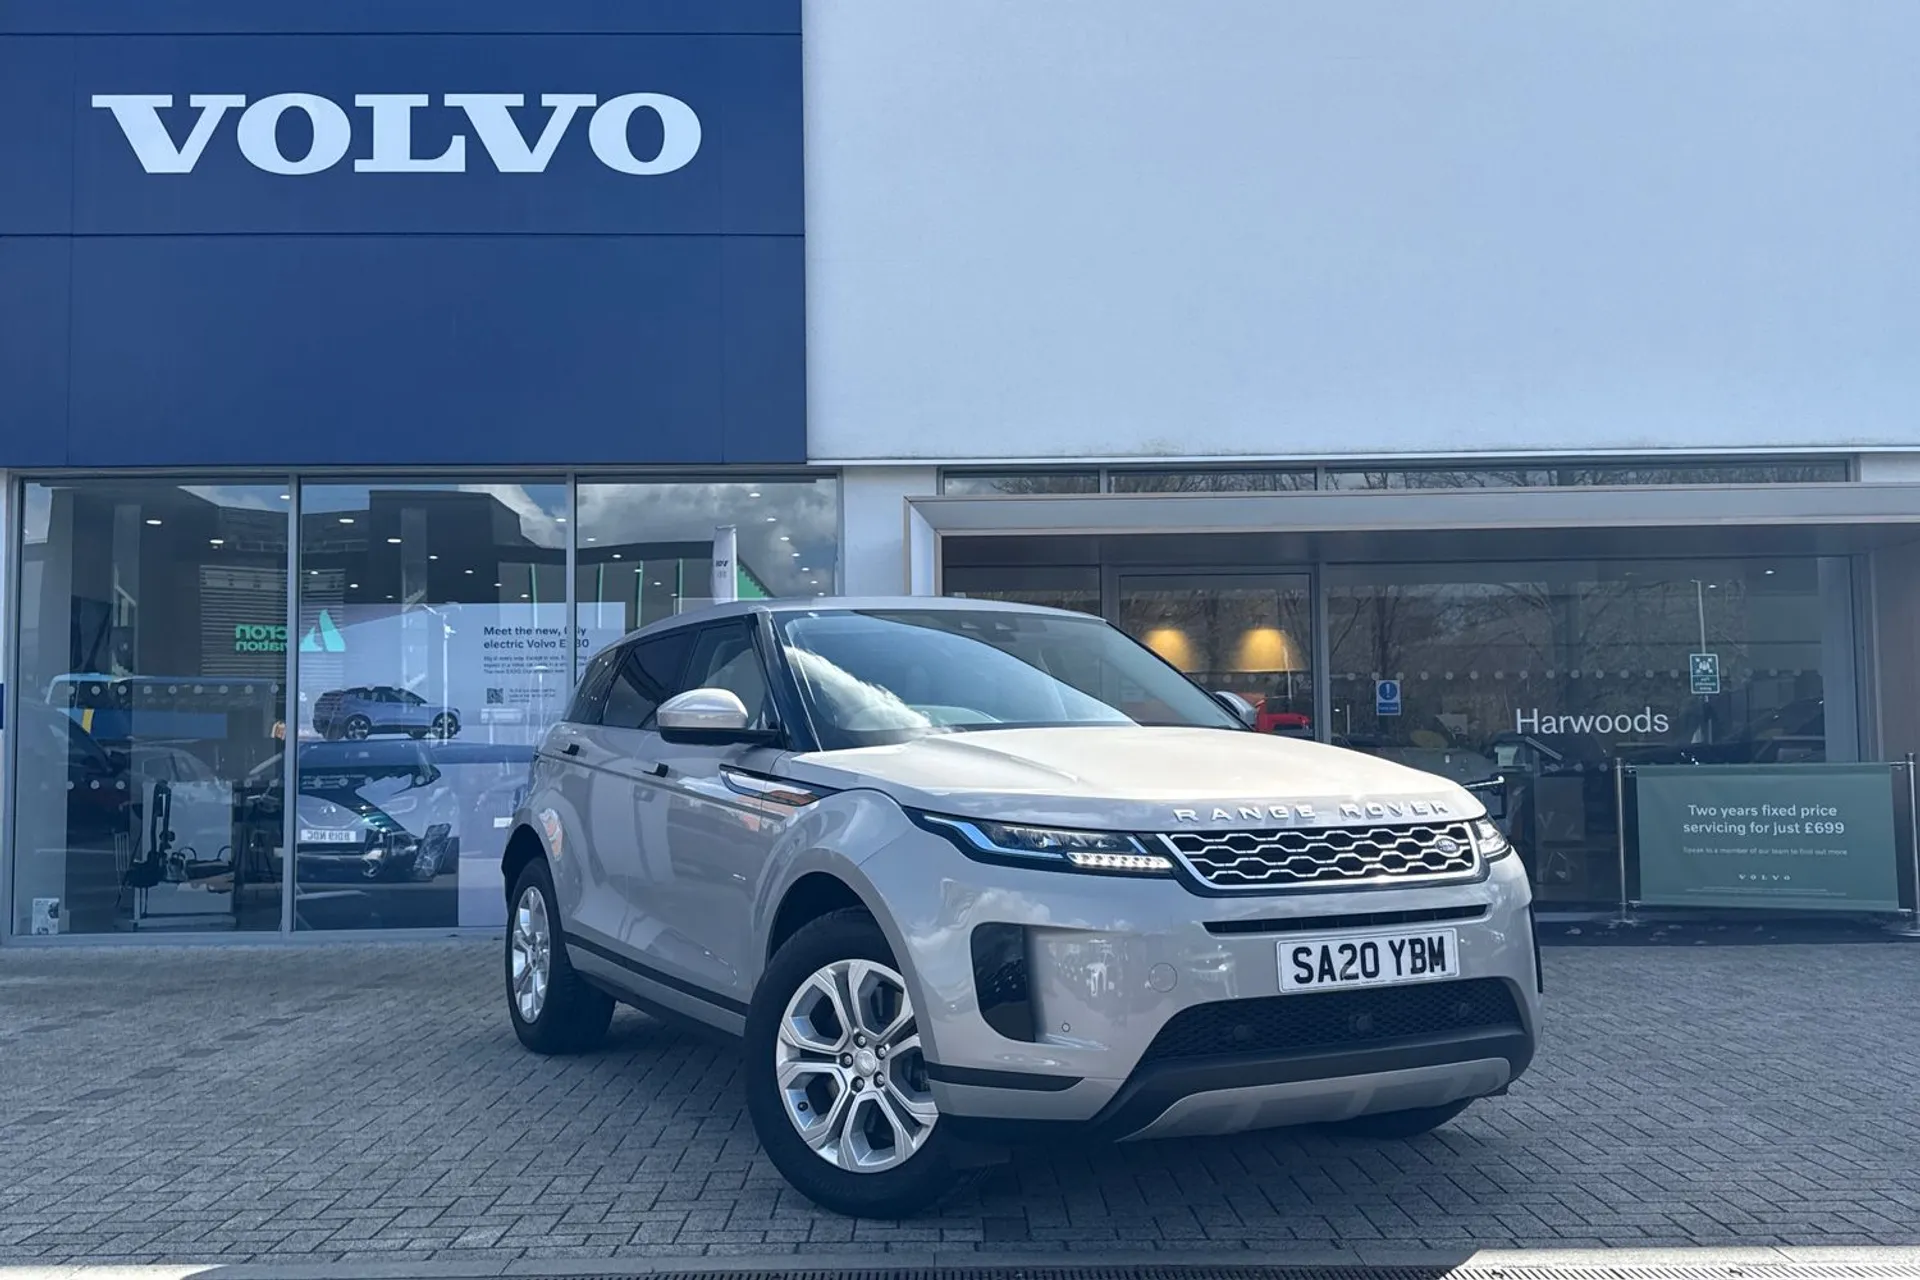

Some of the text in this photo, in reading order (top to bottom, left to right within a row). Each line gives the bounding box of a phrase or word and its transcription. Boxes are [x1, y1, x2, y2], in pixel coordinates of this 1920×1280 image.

[92, 92, 701, 175] VOLVO
[483, 626, 512, 635] Meet
[515, 626, 532, 635] the
[535, 626, 561, 637] new,
[483, 639, 524, 649] electric
[527, 639, 556, 648] Volvo
[1516, 706, 1670, 735] Harwoods
[1173, 800, 1449, 823] RANGE ROVER
[1688, 804, 1837, 819] Two years fixed price
[1683, 821, 1845, 836] servicing for just £699
[1739, 873, 1791, 881] VOLVO
[1292, 934, 1446, 984] SA20 YBM
